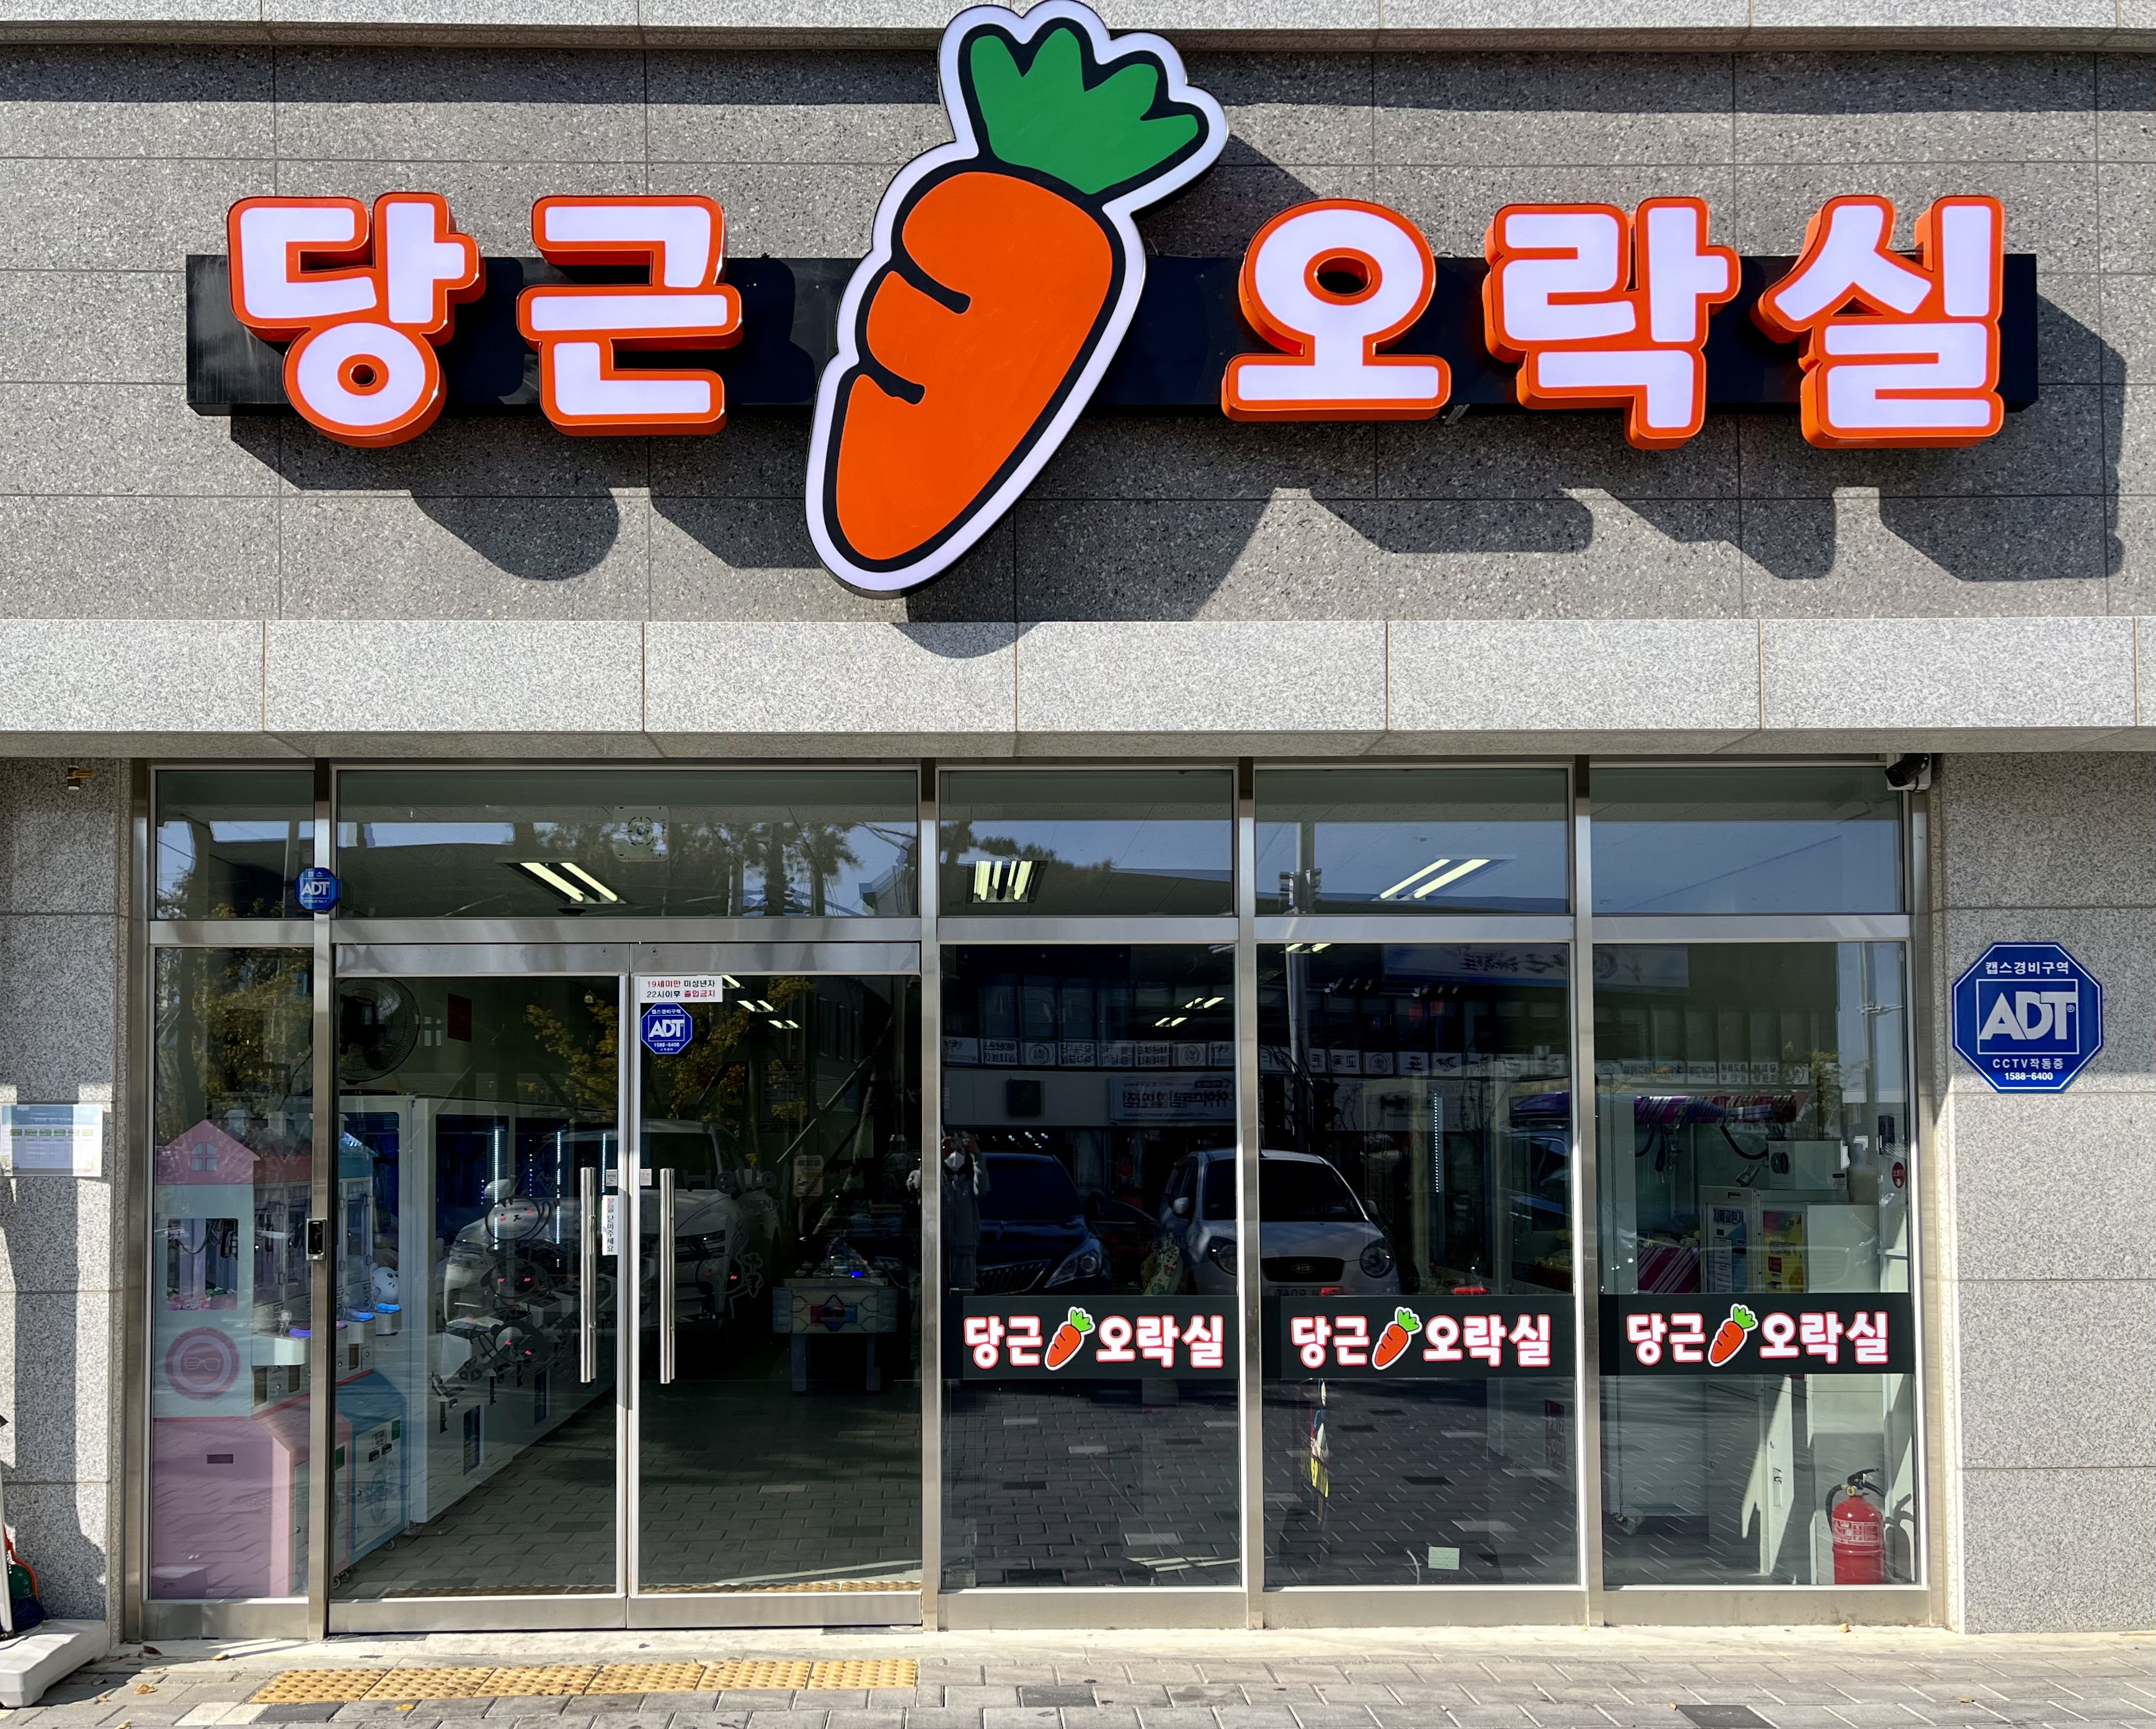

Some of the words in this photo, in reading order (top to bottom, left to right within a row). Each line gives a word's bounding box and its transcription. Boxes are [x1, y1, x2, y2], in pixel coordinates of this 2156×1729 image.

[227, 192, 743, 447] 당근
[1222, 194, 2005, 450] 오락실
[301, 881, 330, 896] ADT
[1985, 961, 2069, 975] 캡스경비구역
[649, 1020, 685, 1037] ADT
[1979, 991, 2077, 1040] ADT
[1992, 1058, 2064, 1070] CCTV작동중
[2004, 1072, 2054, 1080] 1588-6400
[964, 1315, 1043, 1369] 당근
[1096, 1315, 1224, 1368] 오락실
[1290, 1315, 1370, 1369] 당근
[1422, 1314, 1551, 1367] 오락실
[1626, 1313, 1706, 1366] 당근
[1759, 1312, 1889, 1364] 오락실
